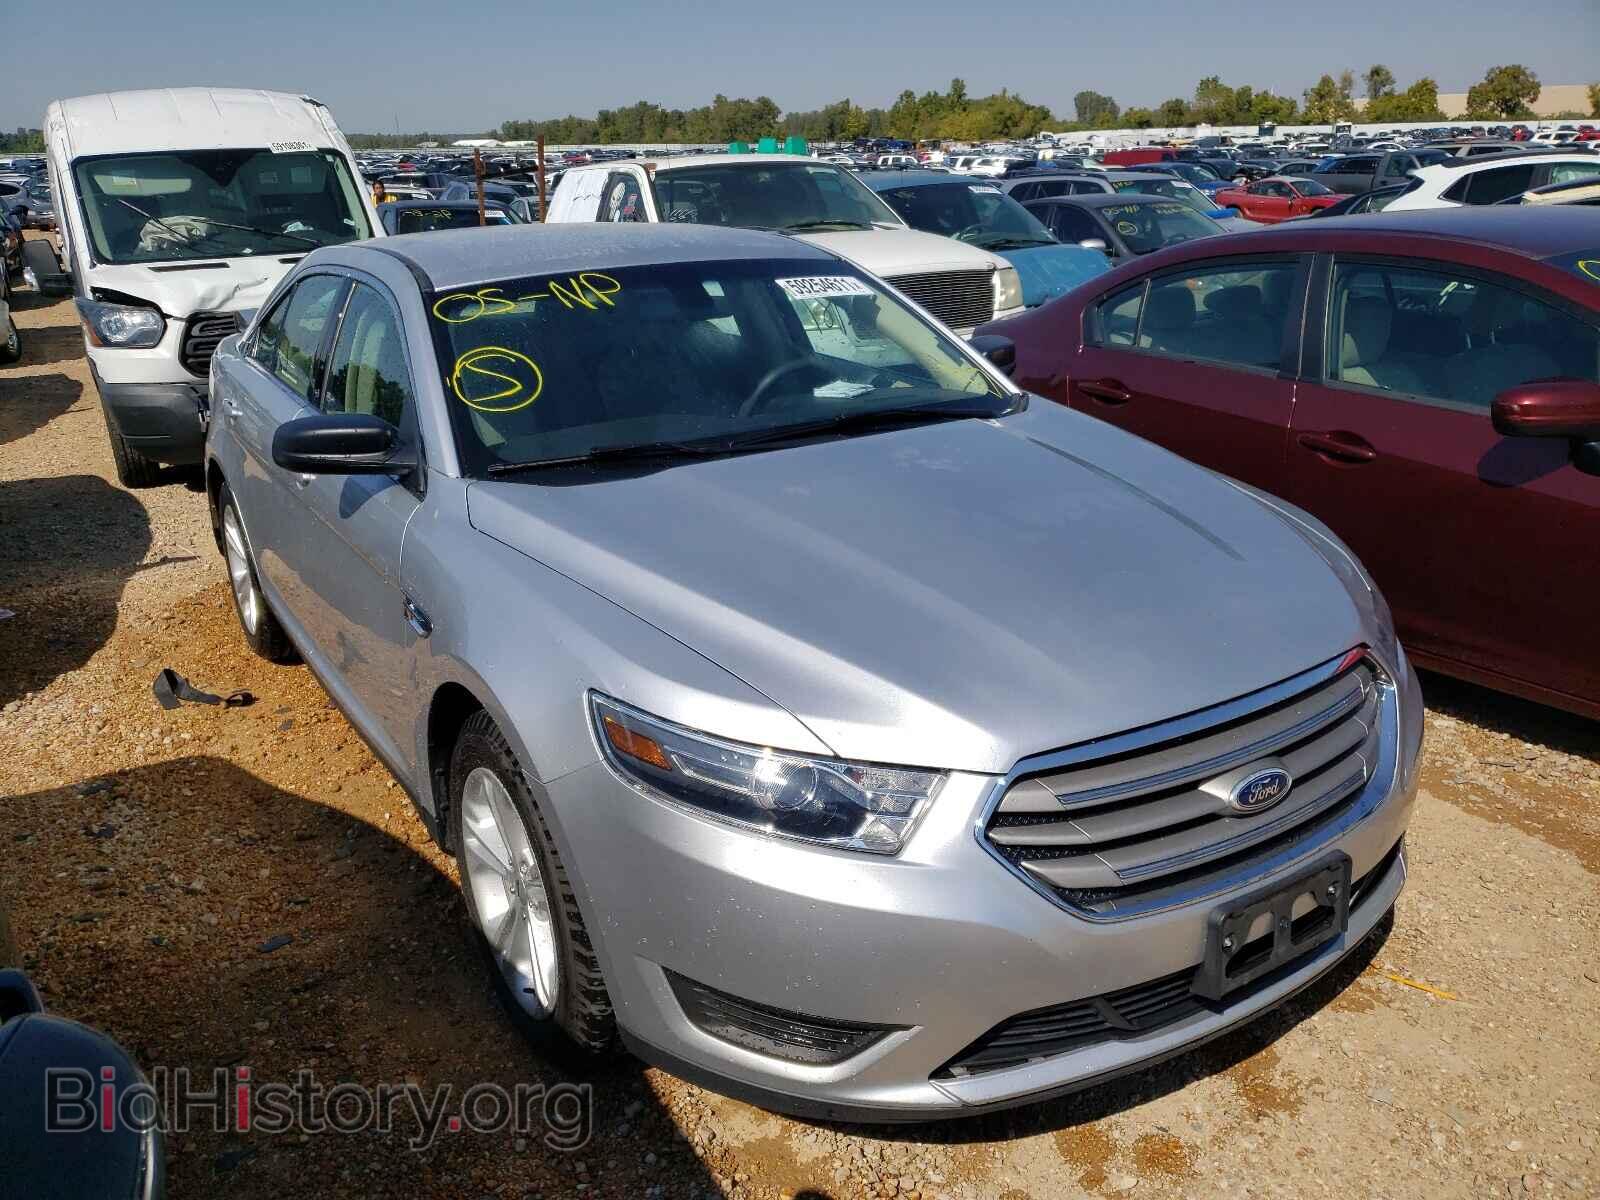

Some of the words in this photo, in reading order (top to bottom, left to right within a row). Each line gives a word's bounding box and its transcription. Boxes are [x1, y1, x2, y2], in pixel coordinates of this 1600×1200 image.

[433, 273, 621, 323] OS-NP
[464, 354, 523, 402] S
[1248, 778, 1280, 804] Ford
